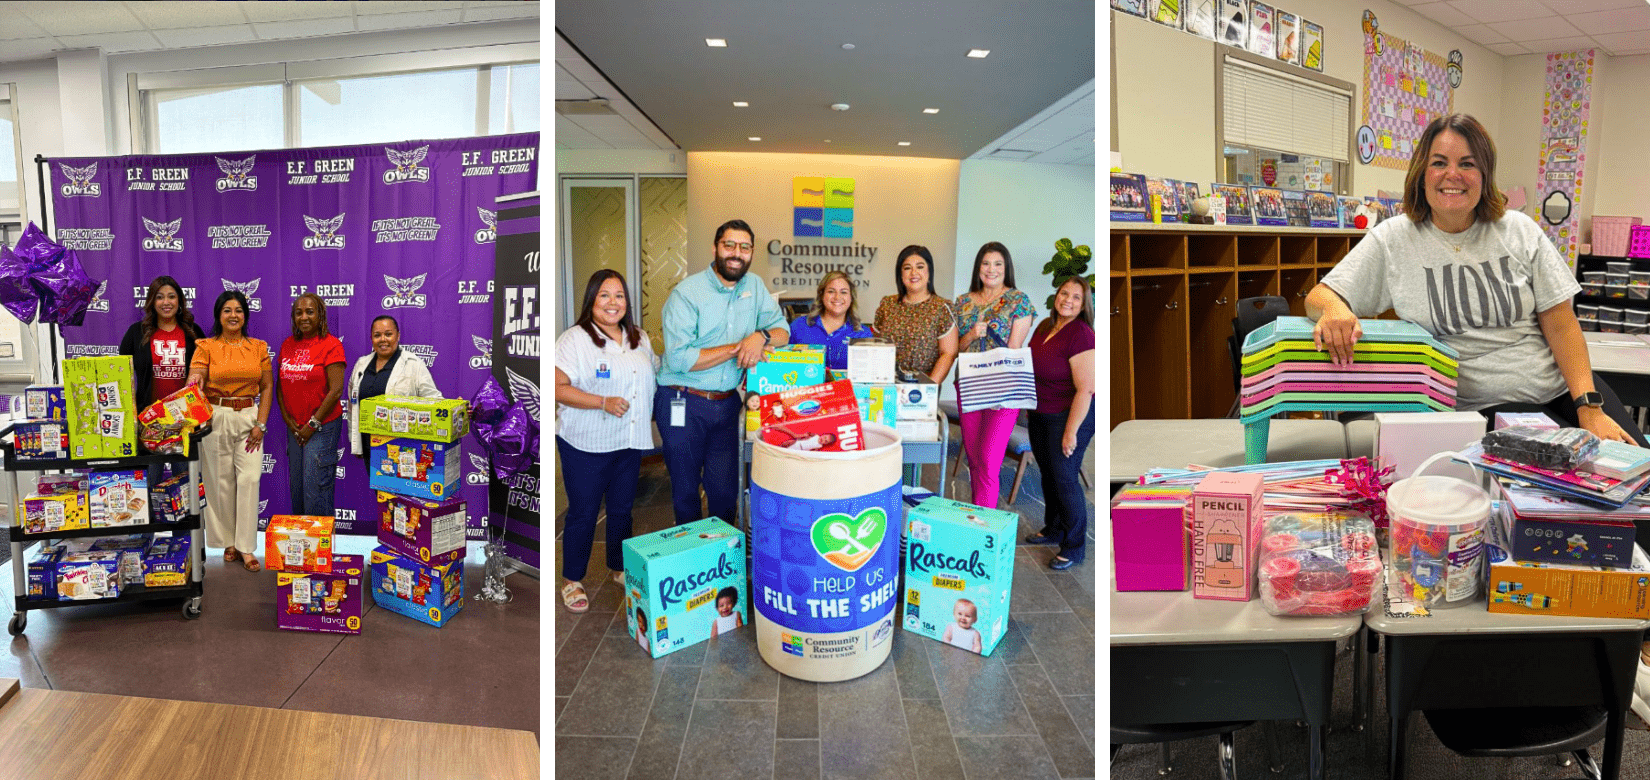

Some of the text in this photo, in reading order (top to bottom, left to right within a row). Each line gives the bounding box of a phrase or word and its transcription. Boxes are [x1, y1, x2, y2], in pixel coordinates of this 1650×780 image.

[462, 148, 535, 166] E.F. GREEN
[287, 158, 355, 174] E.F. GREEN
[462, 163, 530, 176] JUNIOR SCHOOL
[127, 167, 189, 181] E.F. GREEN
[288, 173, 350, 184] JUNIOR SCHOOL
[385, 169, 428, 183] OWLS
[62, 184, 99, 196] OWLS
[127, 181, 186, 191] JUNIOR SCHOOL
[217, 178, 256, 191] OWLS
[395, 218, 411, 229] NOT
[77, 228, 91, 239] NOT
[229, 225, 244, 236] NOT
[391, 230, 408, 242] NOT
[407, 229, 438, 241] GREEN!
[226, 237, 241, 248] NOT
[241, 236, 269, 248] GREEN!
[303, 236, 345, 249] OWLS
[475, 231, 496, 243] OW
[75, 239, 88, 250] NOT
[88, 239, 113, 250] GREEN!
[144, 239, 183, 251] OWLS
[767, 239, 878, 263] Community
[781, 257, 864, 275] Resource
[458, 281, 479, 294] E.F.
[772, 277, 820, 287] CREDIT
[290, 284, 355, 297] E.F GREEN
[1422, 255, 1523, 336] MOM
[382, 297, 426, 310] OWLS
[458, 295, 489, 304] JUNIOR
[86, 345, 100, 355] NOT
[508, 334, 540, 357] JUNI
[471, 357, 492, 368] OW
[107, 386, 117, 407] SKINNY
[780, 384, 834, 400] HUGGIES
[436, 409, 448, 418] 28
[111, 415, 119, 436] SKINNY
[123, 443, 132, 455] 28
[468, 474, 489, 484] OW
[433, 484, 441, 493] 50
[508, 490, 530, 509] IT'S
[1202, 501, 1244, 511] PENCIL
[335, 508, 357, 520] EEN
[467, 528, 485, 537] NIOR
[984, 535, 994, 549] 3
[1194, 521, 1205, 588] HAND FREE
[936, 577, 962, 590] DIAPERS
[689, 592, 716, 610] DIAPERS
[911, 591, 919, 600] 12
[431, 610, 439, 618] 50
[806, 598, 850, 618] THE
[321, 616, 345, 624] flavor
[922, 622, 935, 631] 184
[805, 635, 860, 647] Community
[813, 645, 854, 654] Resource
